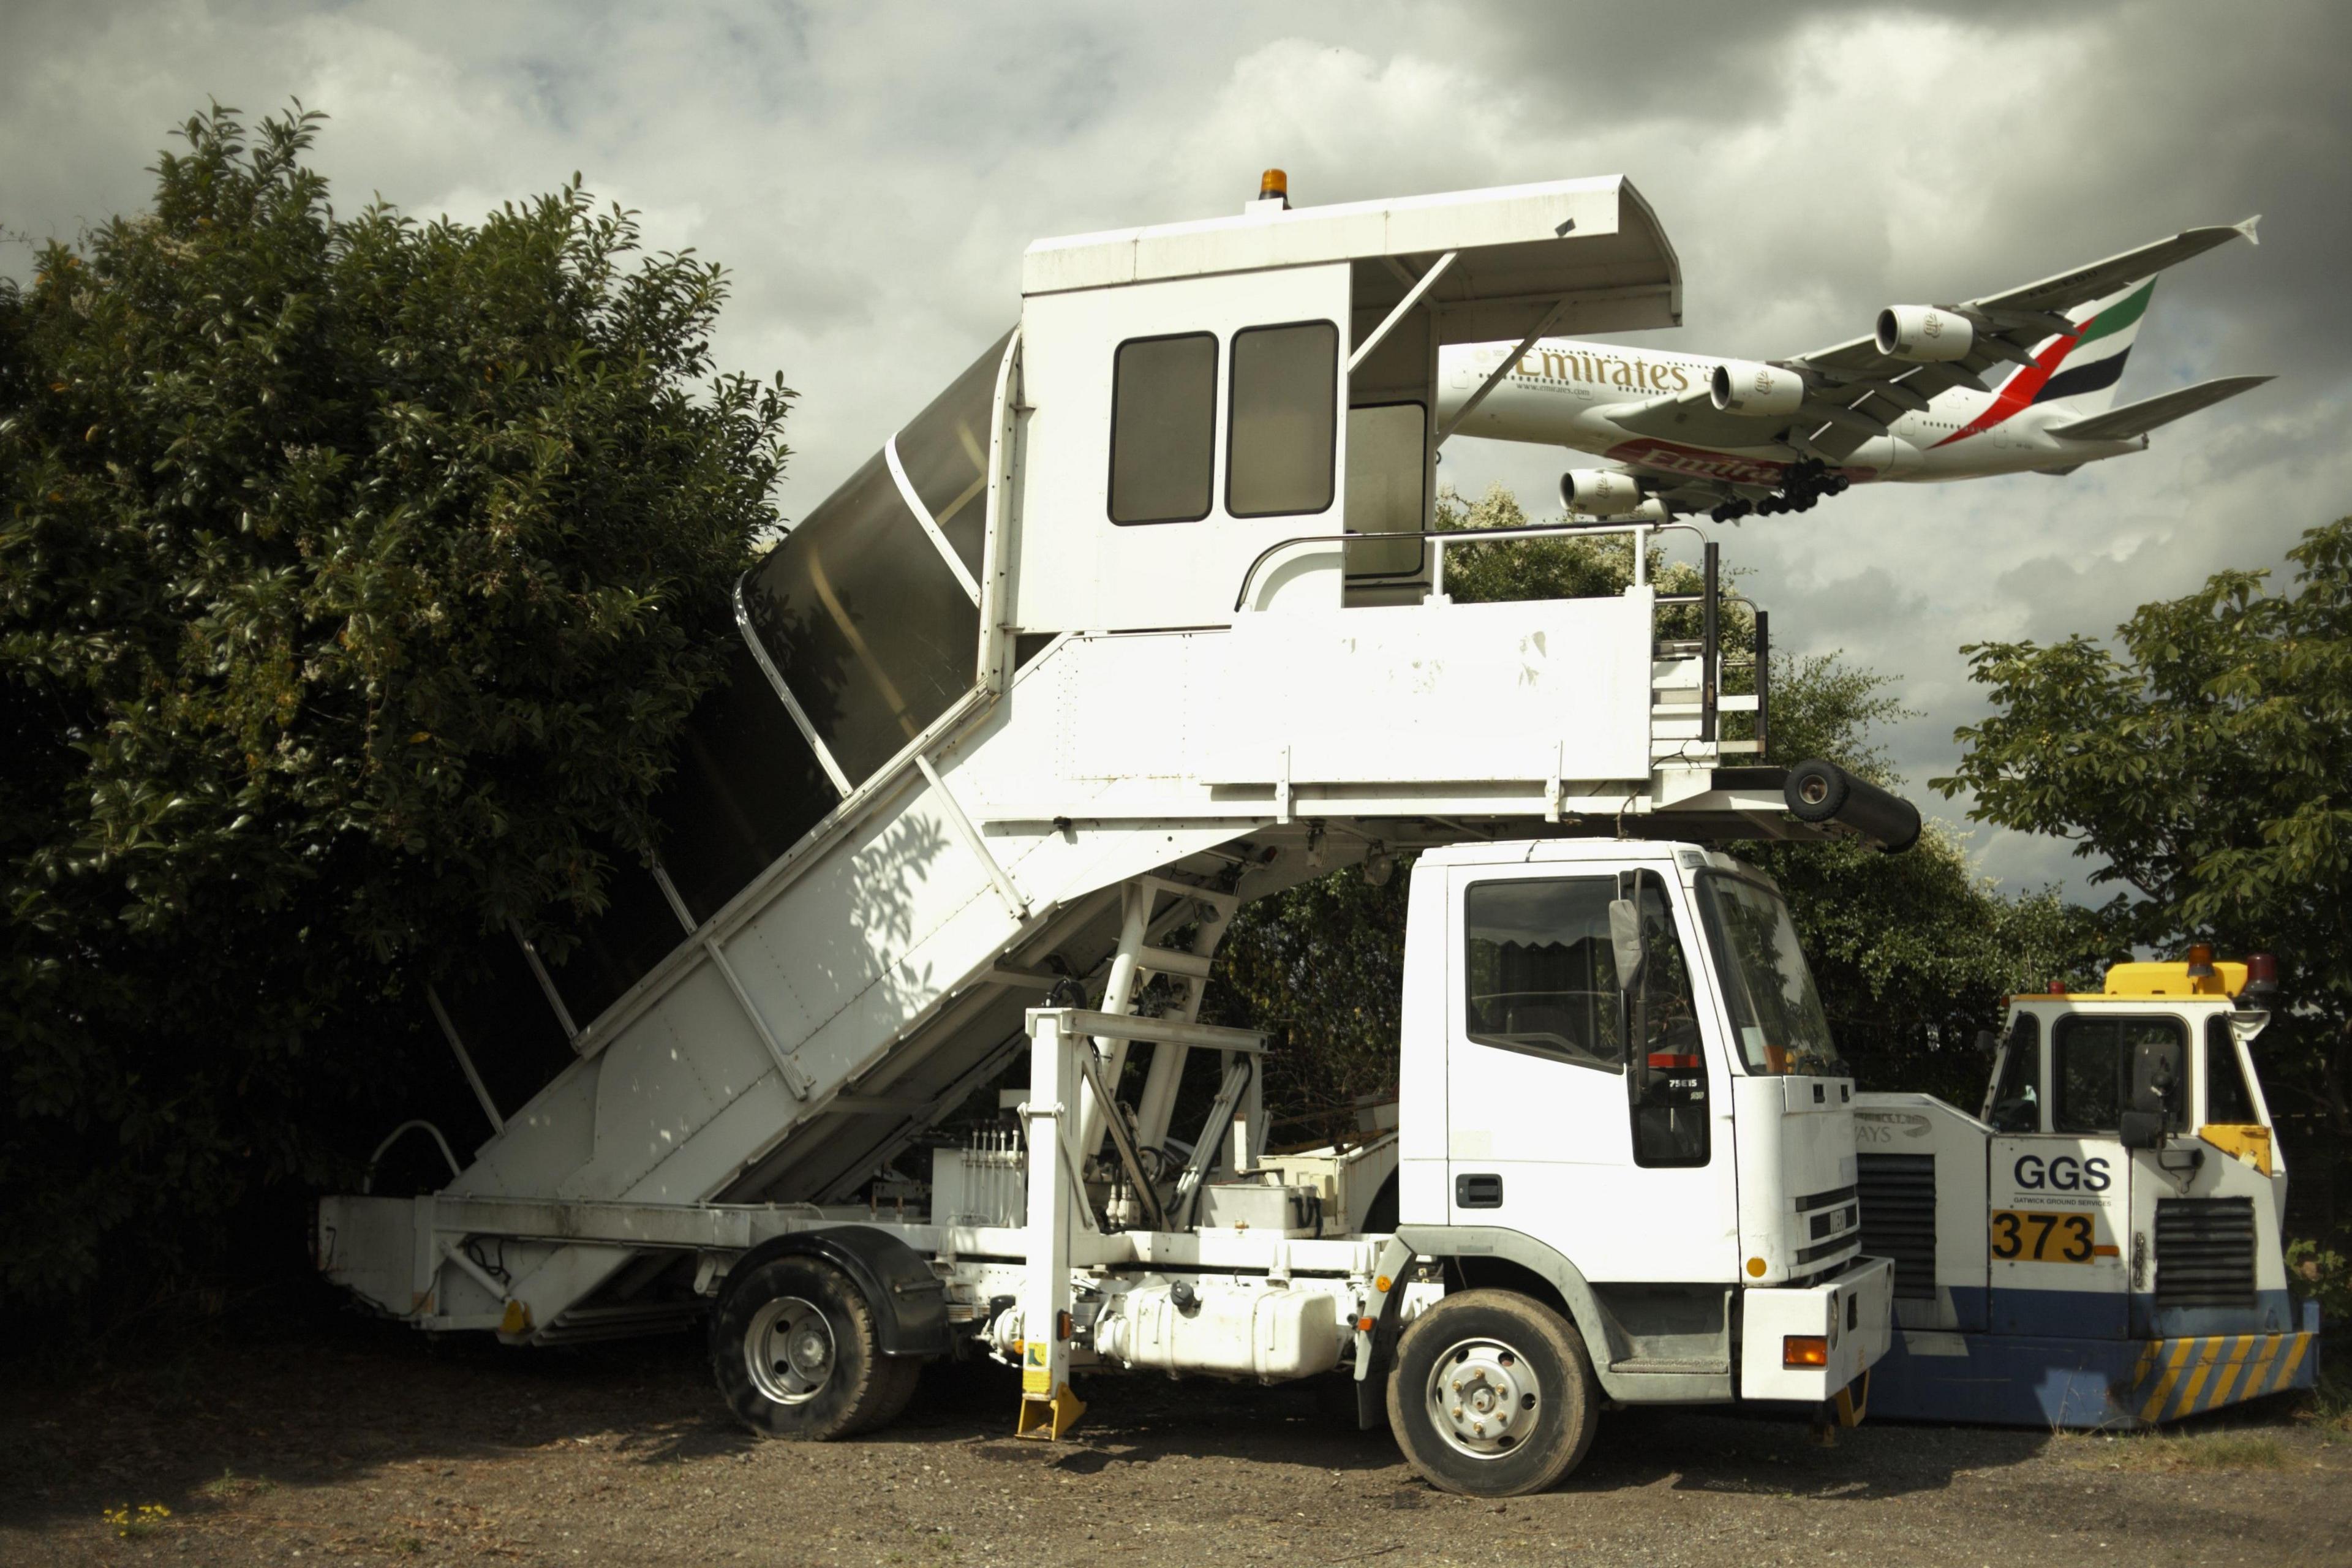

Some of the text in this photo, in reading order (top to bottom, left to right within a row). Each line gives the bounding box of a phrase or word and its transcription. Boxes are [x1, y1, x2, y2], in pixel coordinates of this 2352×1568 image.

[1511, 345, 1689, 391] Emirates
[1516, 383, 1590, 396] www.emirates.com
[1638, 448, 1782, 481] Emira
[1669, 1079, 1697, 1088] 75E15
[1855, 1126, 1891, 1143] AYS
[2014, 1155, 2111, 1192] GGS
[1992, 1212, 2094, 1262] 373
